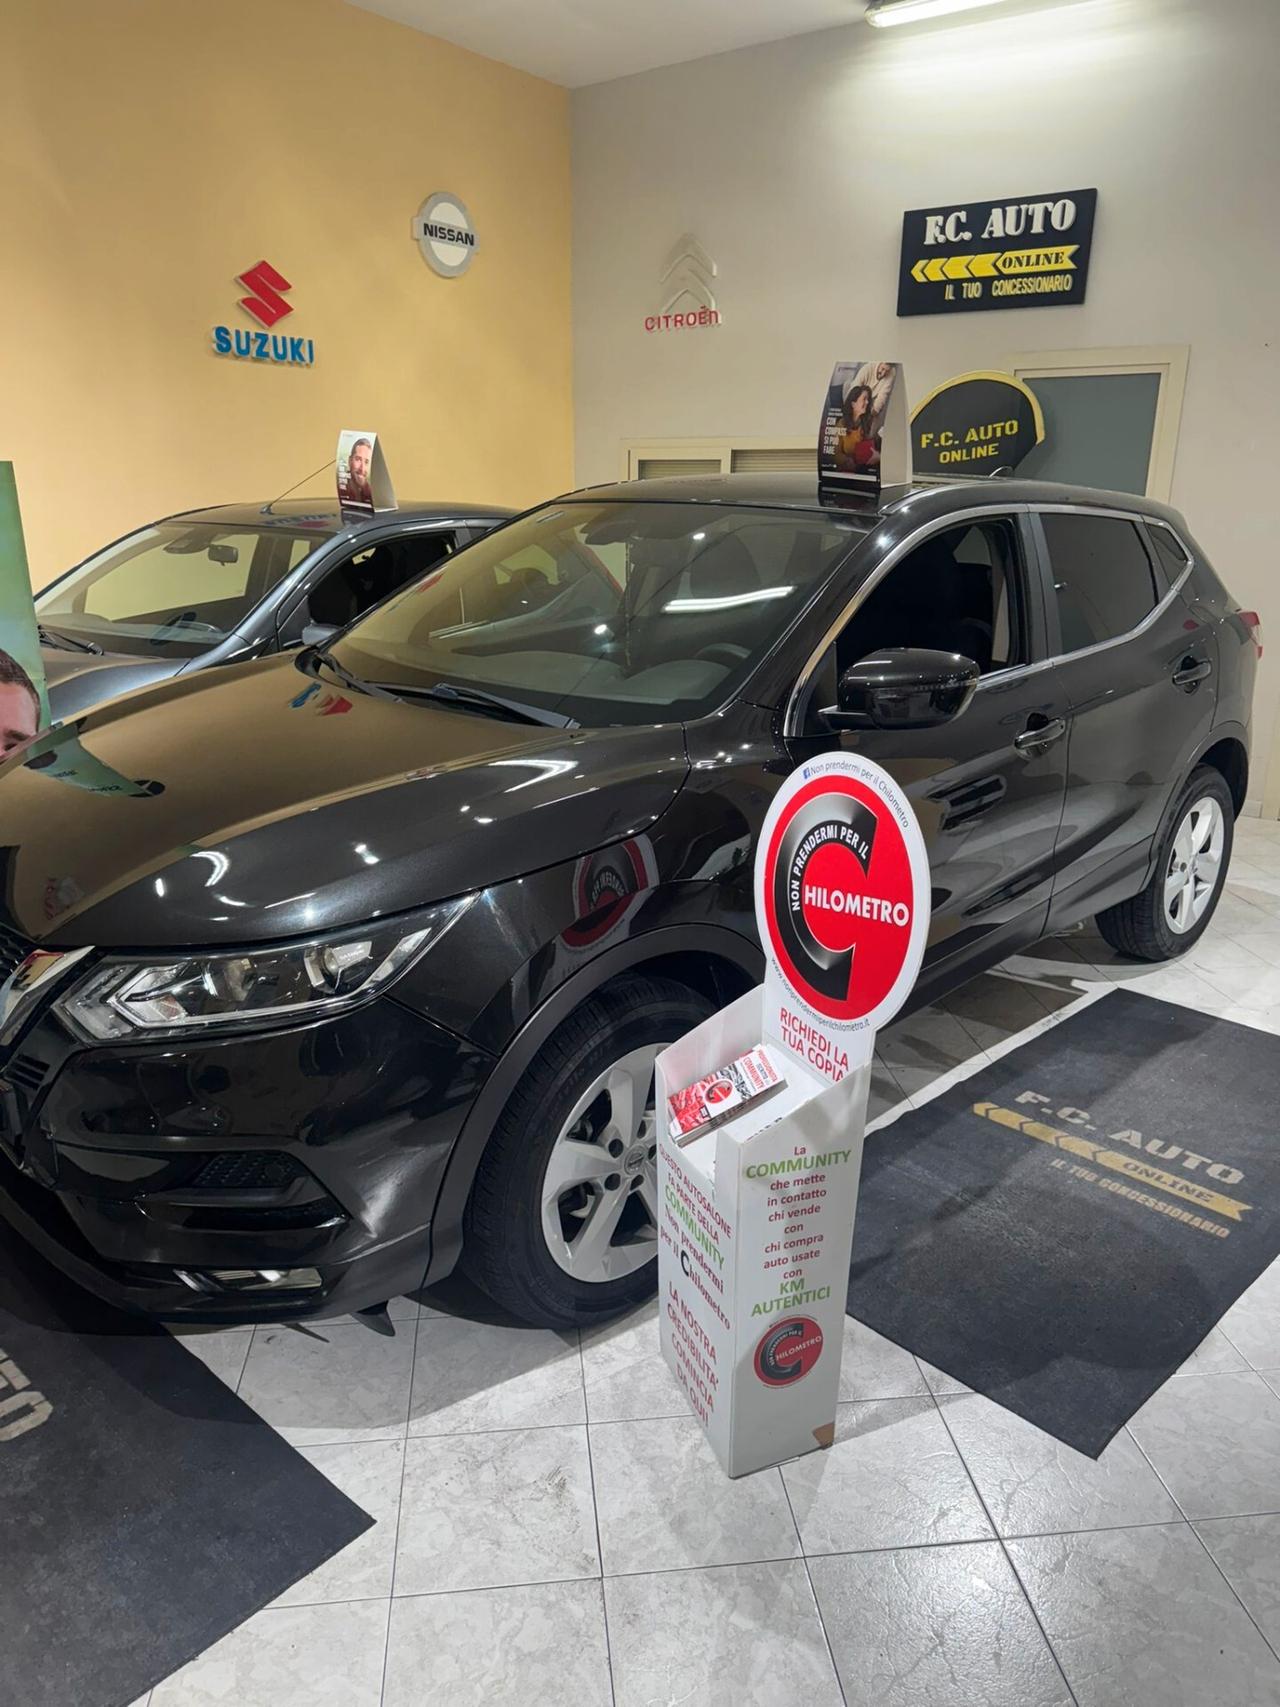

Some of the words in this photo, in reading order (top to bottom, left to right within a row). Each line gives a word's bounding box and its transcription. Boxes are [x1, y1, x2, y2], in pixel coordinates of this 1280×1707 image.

[423, 222, 474, 246] NISSAN
[923, 210, 972, 245] F.C.
[981, 199, 1076, 239] AUTO
[1002, 251, 1065, 269] ONLINE
[944, 284, 955, 300] IL
[962, 282, 982, 299] TUO
[992, 274, 1073, 297] CONCESSIONARIO
[213, 325, 316, 366] SUZUKI
[921, 431, 959, 449] F.C.
[965, 420, 1019, 443] AUTO
[939, 443, 999, 464] ONLINE
[810, 764, 825, 775] Non
[825, 761, 860, 773] prendermi
[860, 768, 873, 781] per
[872, 774, 880, 785] il
[878, 780, 909, 829] Chilometro
[793, 825, 838, 877] PRENDERMI
[840, 826, 860, 846] PER
[858, 841, 869, 860] IL
[791, 879, 801, 912] NON
[804, 884, 910, 927] HILOMETRO
[780, 1007, 831, 1057] RICHIEDI
[834, 1046, 849, 1072] LA
[781, 1025, 805, 1057] TUA
[807, 1047, 844, 1083] COPIA
[794, 1146, 806, 1156] La
[1014, 1090, 1097, 1131] F.C.
[1107, 1129, 1246, 1185] AUTO
[746, 1150, 851, 1180] COMMUNITY
[659, 1143, 683, 1181] QUESTO
[683, 1174, 732, 1240] AUTOSALONE
[770, 1180, 790, 1191] che
[793, 1174, 826, 1187] mette
[1122, 1161, 1216, 1203] ONLINE
[667, 1172, 677, 1191] FA
[676, 1181, 696, 1210] PARTE
[697, 1208, 719, 1246] DELLA
[767, 1197, 778, 1207] in
[781, 1190, 827, 1204] contatto
[768, 1211, 785, 1222] chi
[787, 1204, 821, 1219] vende
[1050, 1158, 1067, 1170] IL
[1068, 1165, 1098, 1182] TUO
[1099, 1177, 1231, 1239] CONCESSIONARIO
[665, 1184, 725, 1272] COMMUNITY
[784, 1224, 804, 1234] con
[665, 1203, 680, 1234] Non
[681, 1228, 724, 1294] prendermi
[763, 1257, 789, 1269] auto
[792, 1249, 821, 1263] usate
[764, 1242, 781, 1254] chi
[783, 1234, 824, 1252] compra
[660, 1223, 673, 1246] per
[673, 1242, 680, 1259] il
[680, 1249, 731, 1330] Chilometro
[779, 1278, 805, 1295] KM
[783, 1269, 803, 1280] con
[751, 1286, 831, 1317] AUTENTICI
[669, 1281, 680, 1307] LA
[681, 1299, 717, 1365] NOSTRA
[671, 1333, 714, 1413] COMINCIA
[676, 1363, 689, 1390] DA
